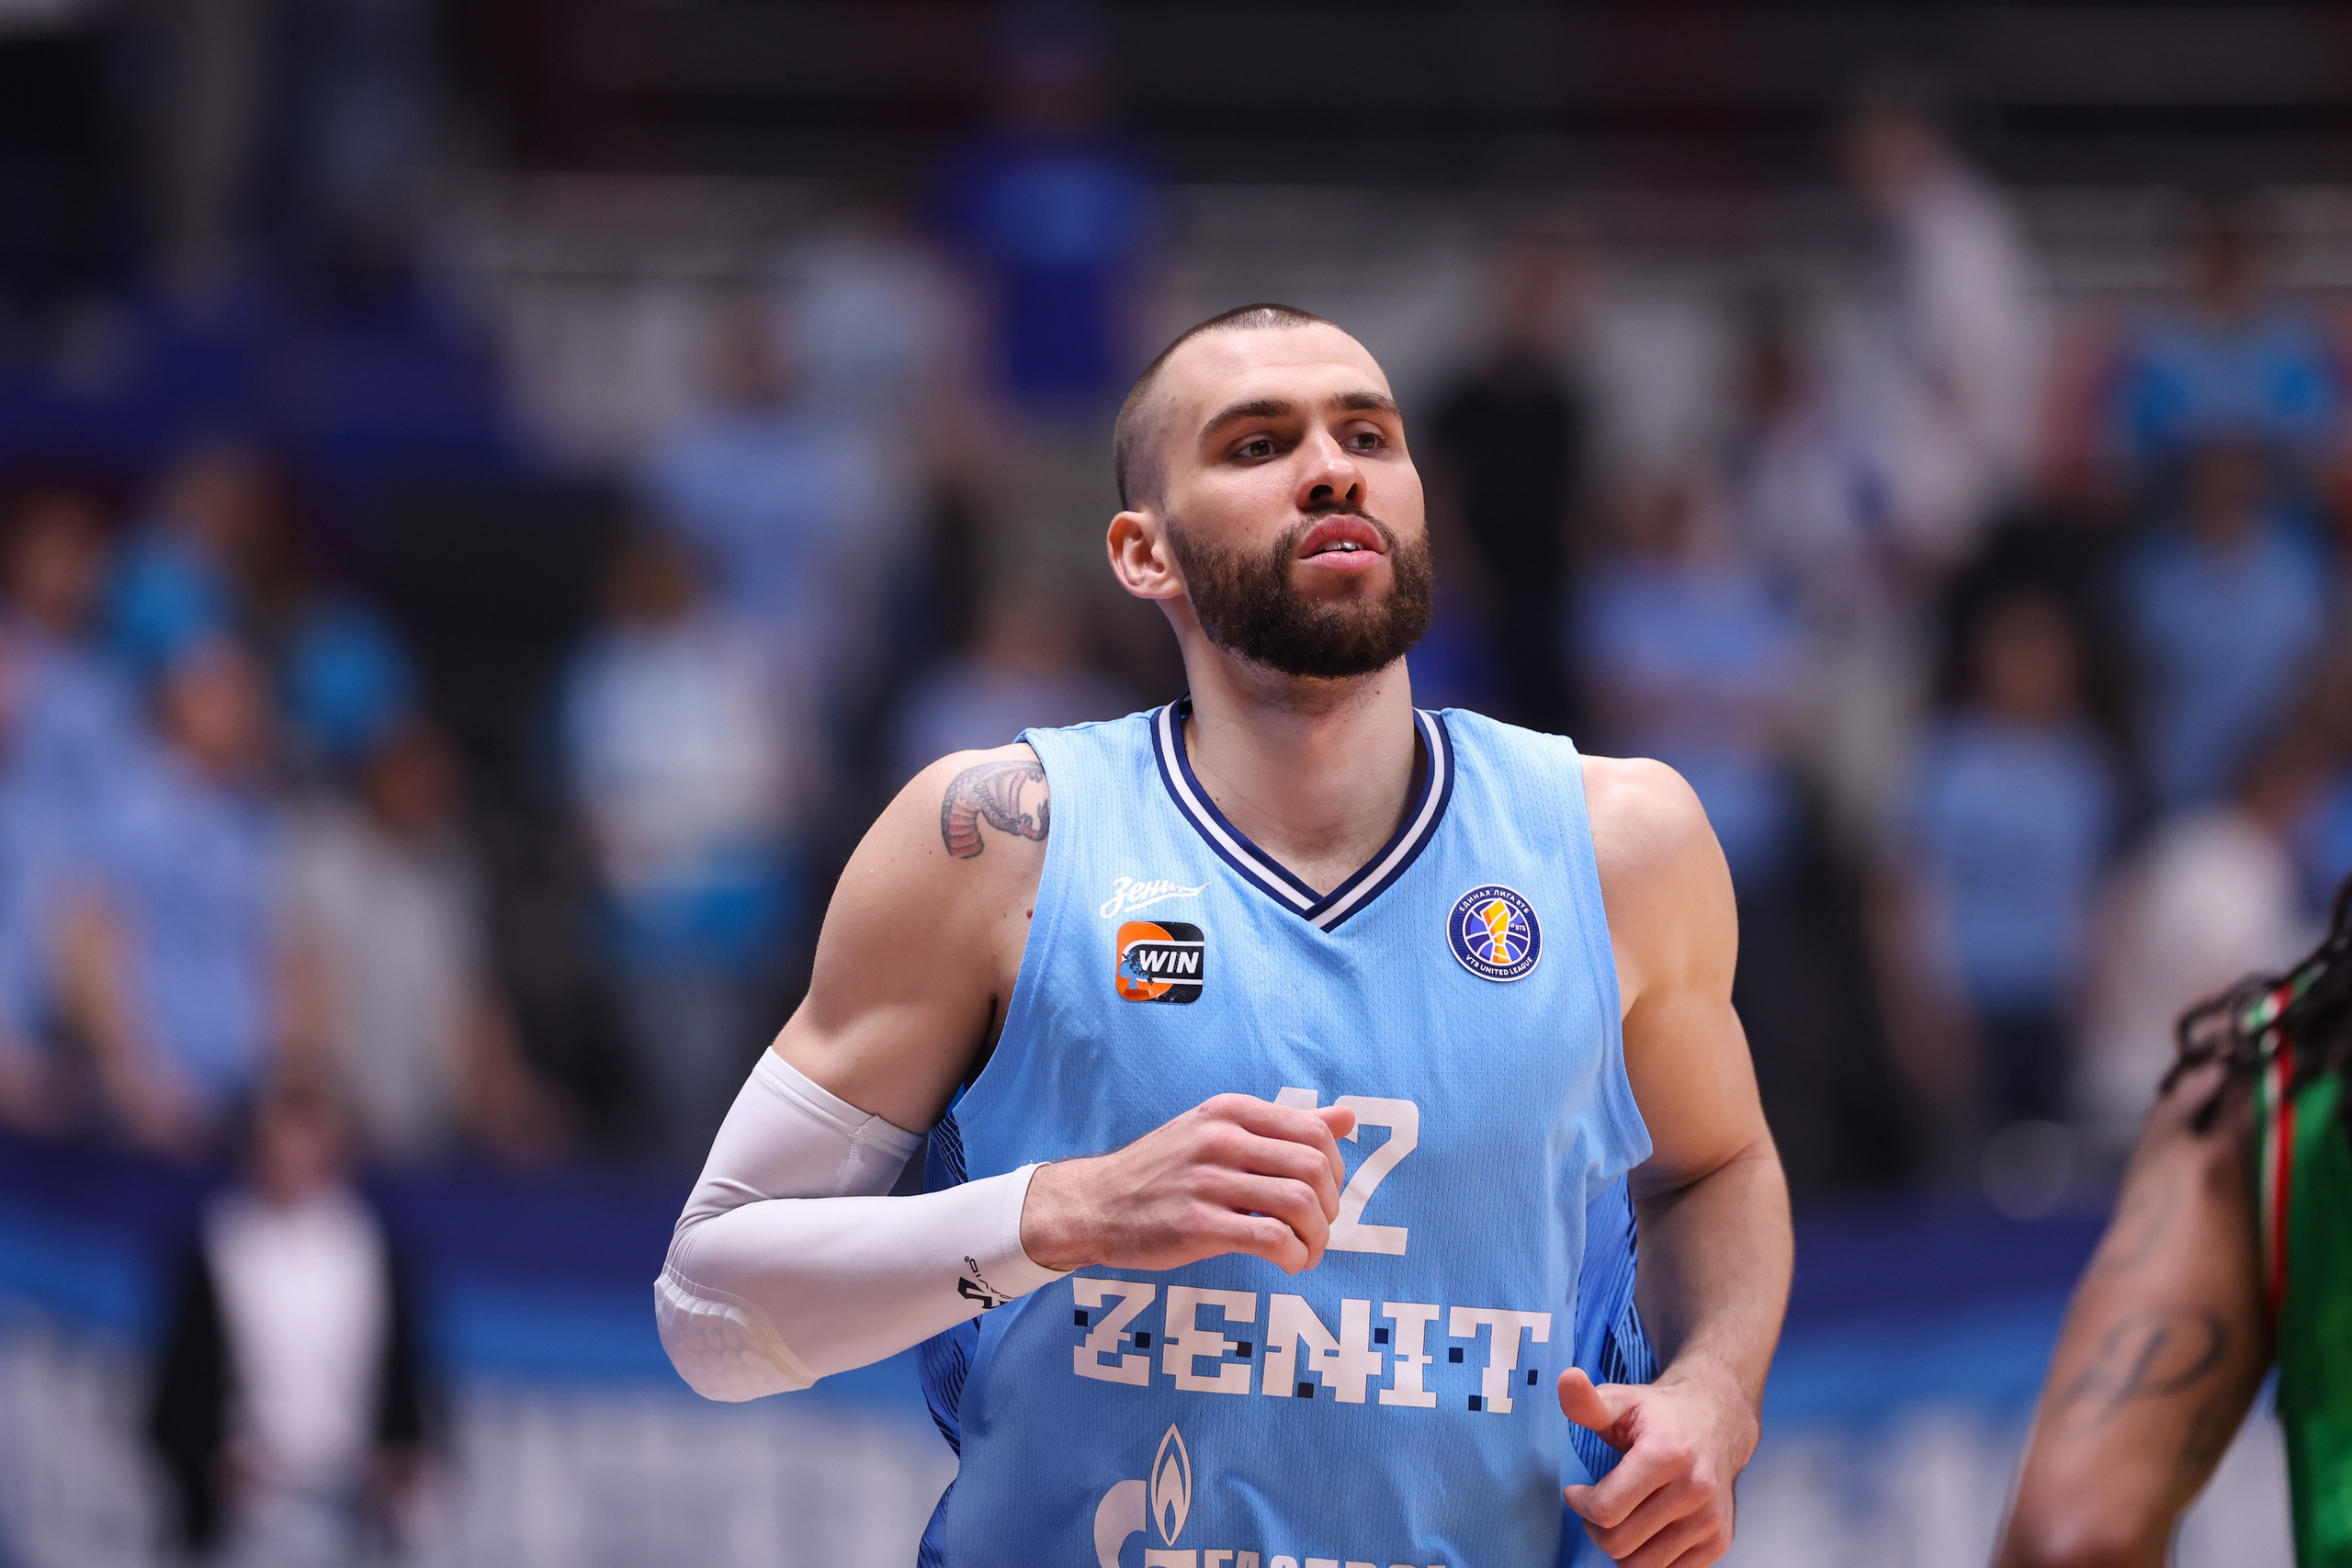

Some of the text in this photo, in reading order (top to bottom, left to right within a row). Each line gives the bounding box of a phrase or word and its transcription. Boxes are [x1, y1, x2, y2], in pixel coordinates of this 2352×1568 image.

[1459, 889, 1530, 914] ЕДИНАЯ ЛИГА ВТБ
[1465, 954, 1533, 976] VTB UNITED LEAGUE
[1273, 1087, 1419, 1256] 2
[1073, 1277, 1552, 1414] ZENIT
